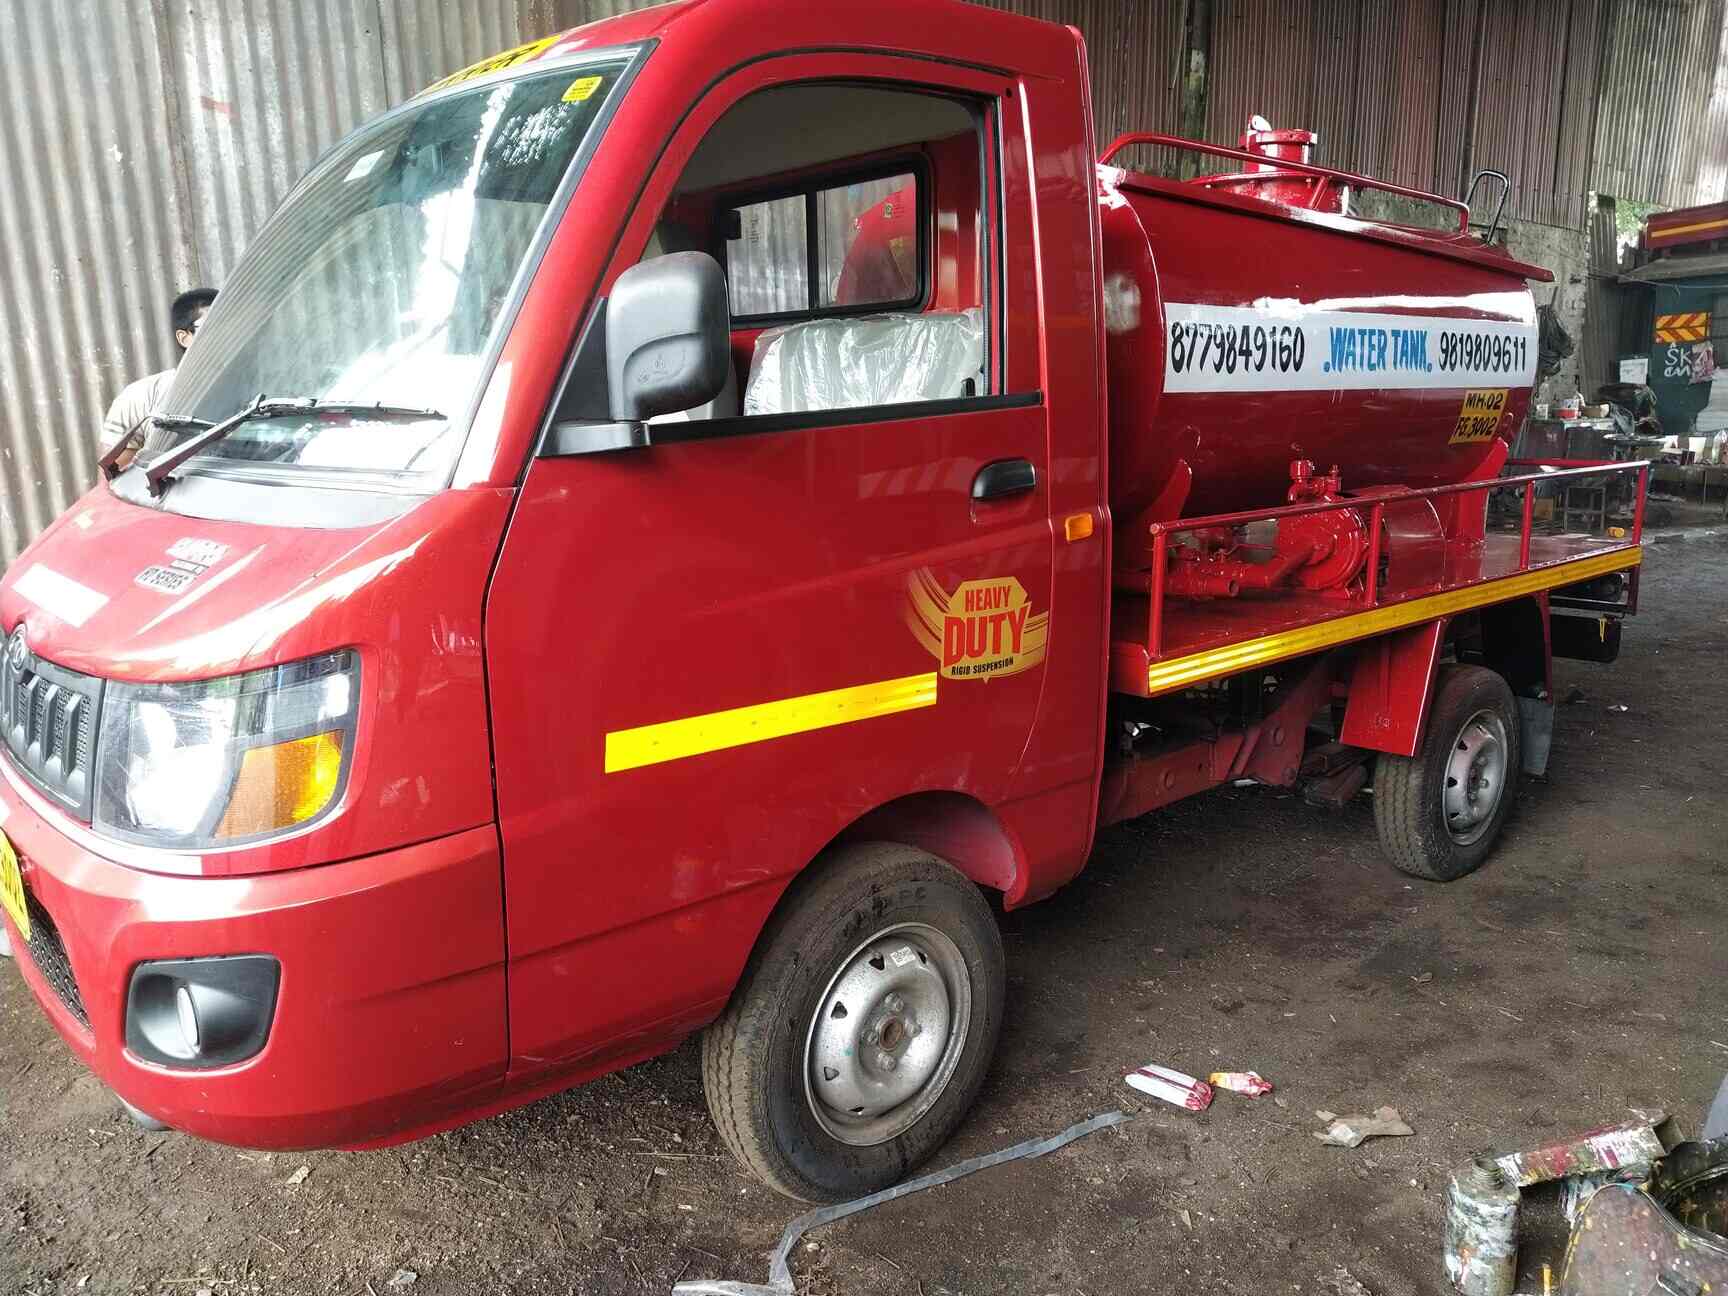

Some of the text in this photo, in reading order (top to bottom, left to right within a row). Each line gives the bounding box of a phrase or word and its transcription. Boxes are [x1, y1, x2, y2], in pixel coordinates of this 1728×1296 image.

[1171, 321, 1305, 375] 8779849160
[1439, 331, 1526, 373] 9819809611
[964, 584, 1012, 613] HEAVY
[943, 605, 1028, 668] DUTY
[951, 656, 1014, 676] RIGID SUSPENSION
